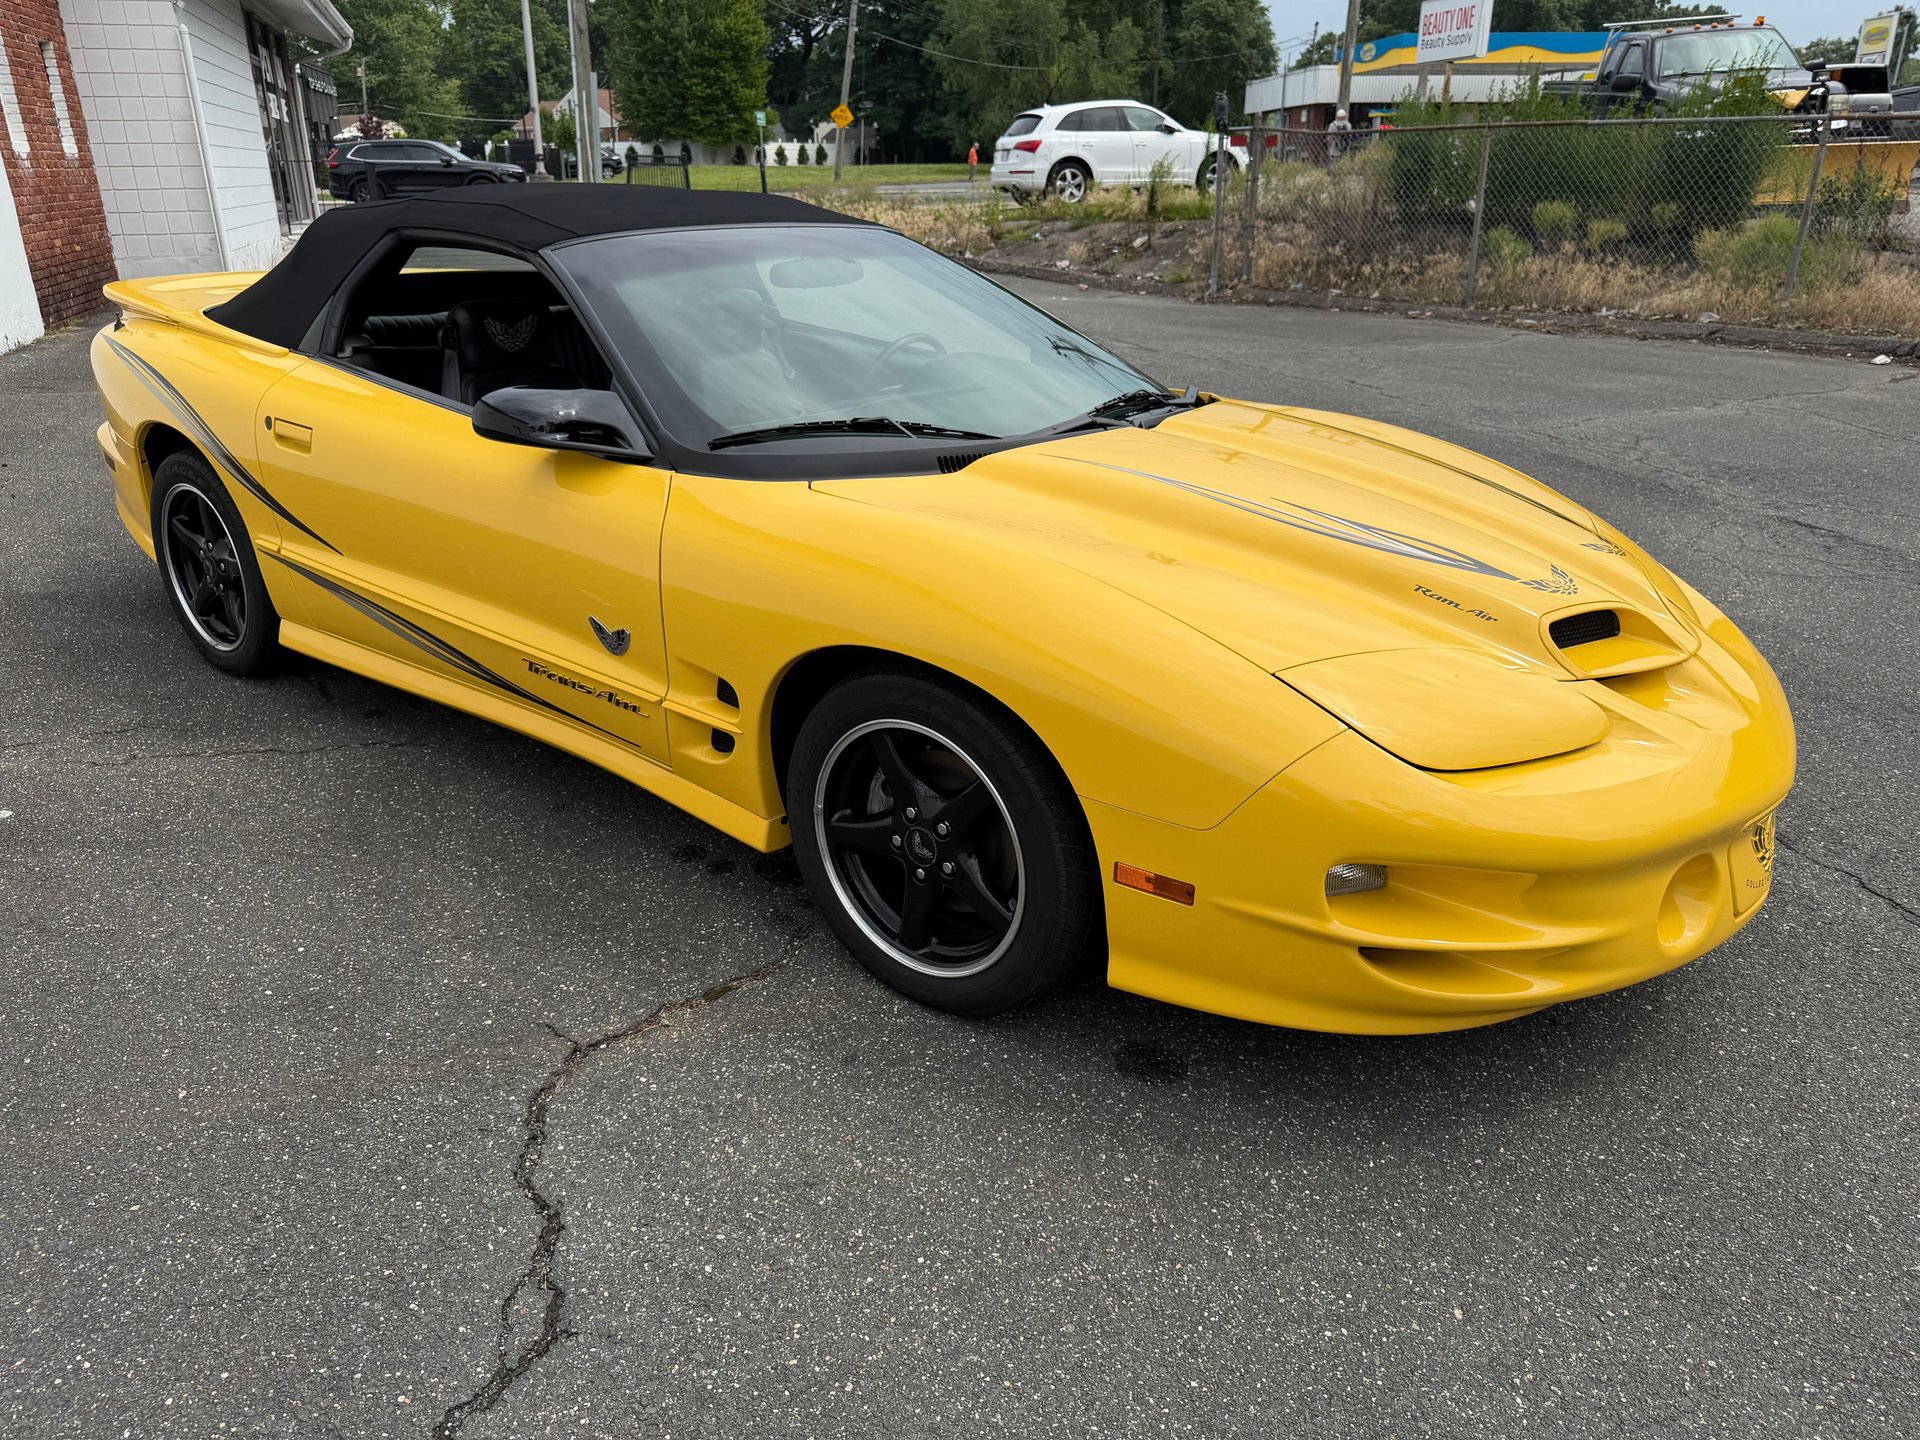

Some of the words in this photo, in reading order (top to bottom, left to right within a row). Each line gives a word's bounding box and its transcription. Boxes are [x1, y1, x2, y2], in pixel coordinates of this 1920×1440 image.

[1422, 9, 1456, 36] BEAUTY
[1456, 5, 1476, 31] ONE
[1421, 37, 1446, 50] Beauty
[1446, 31, 1473, 46] Supply
[1414, 584, 1465, 611] Ram
[1466, 608, 1499, 623] Air
[521, 658, 596, 696] Trans
[596, 689, 649, 719] Am
[1746, 873, 1771, 889] COLLECTO
